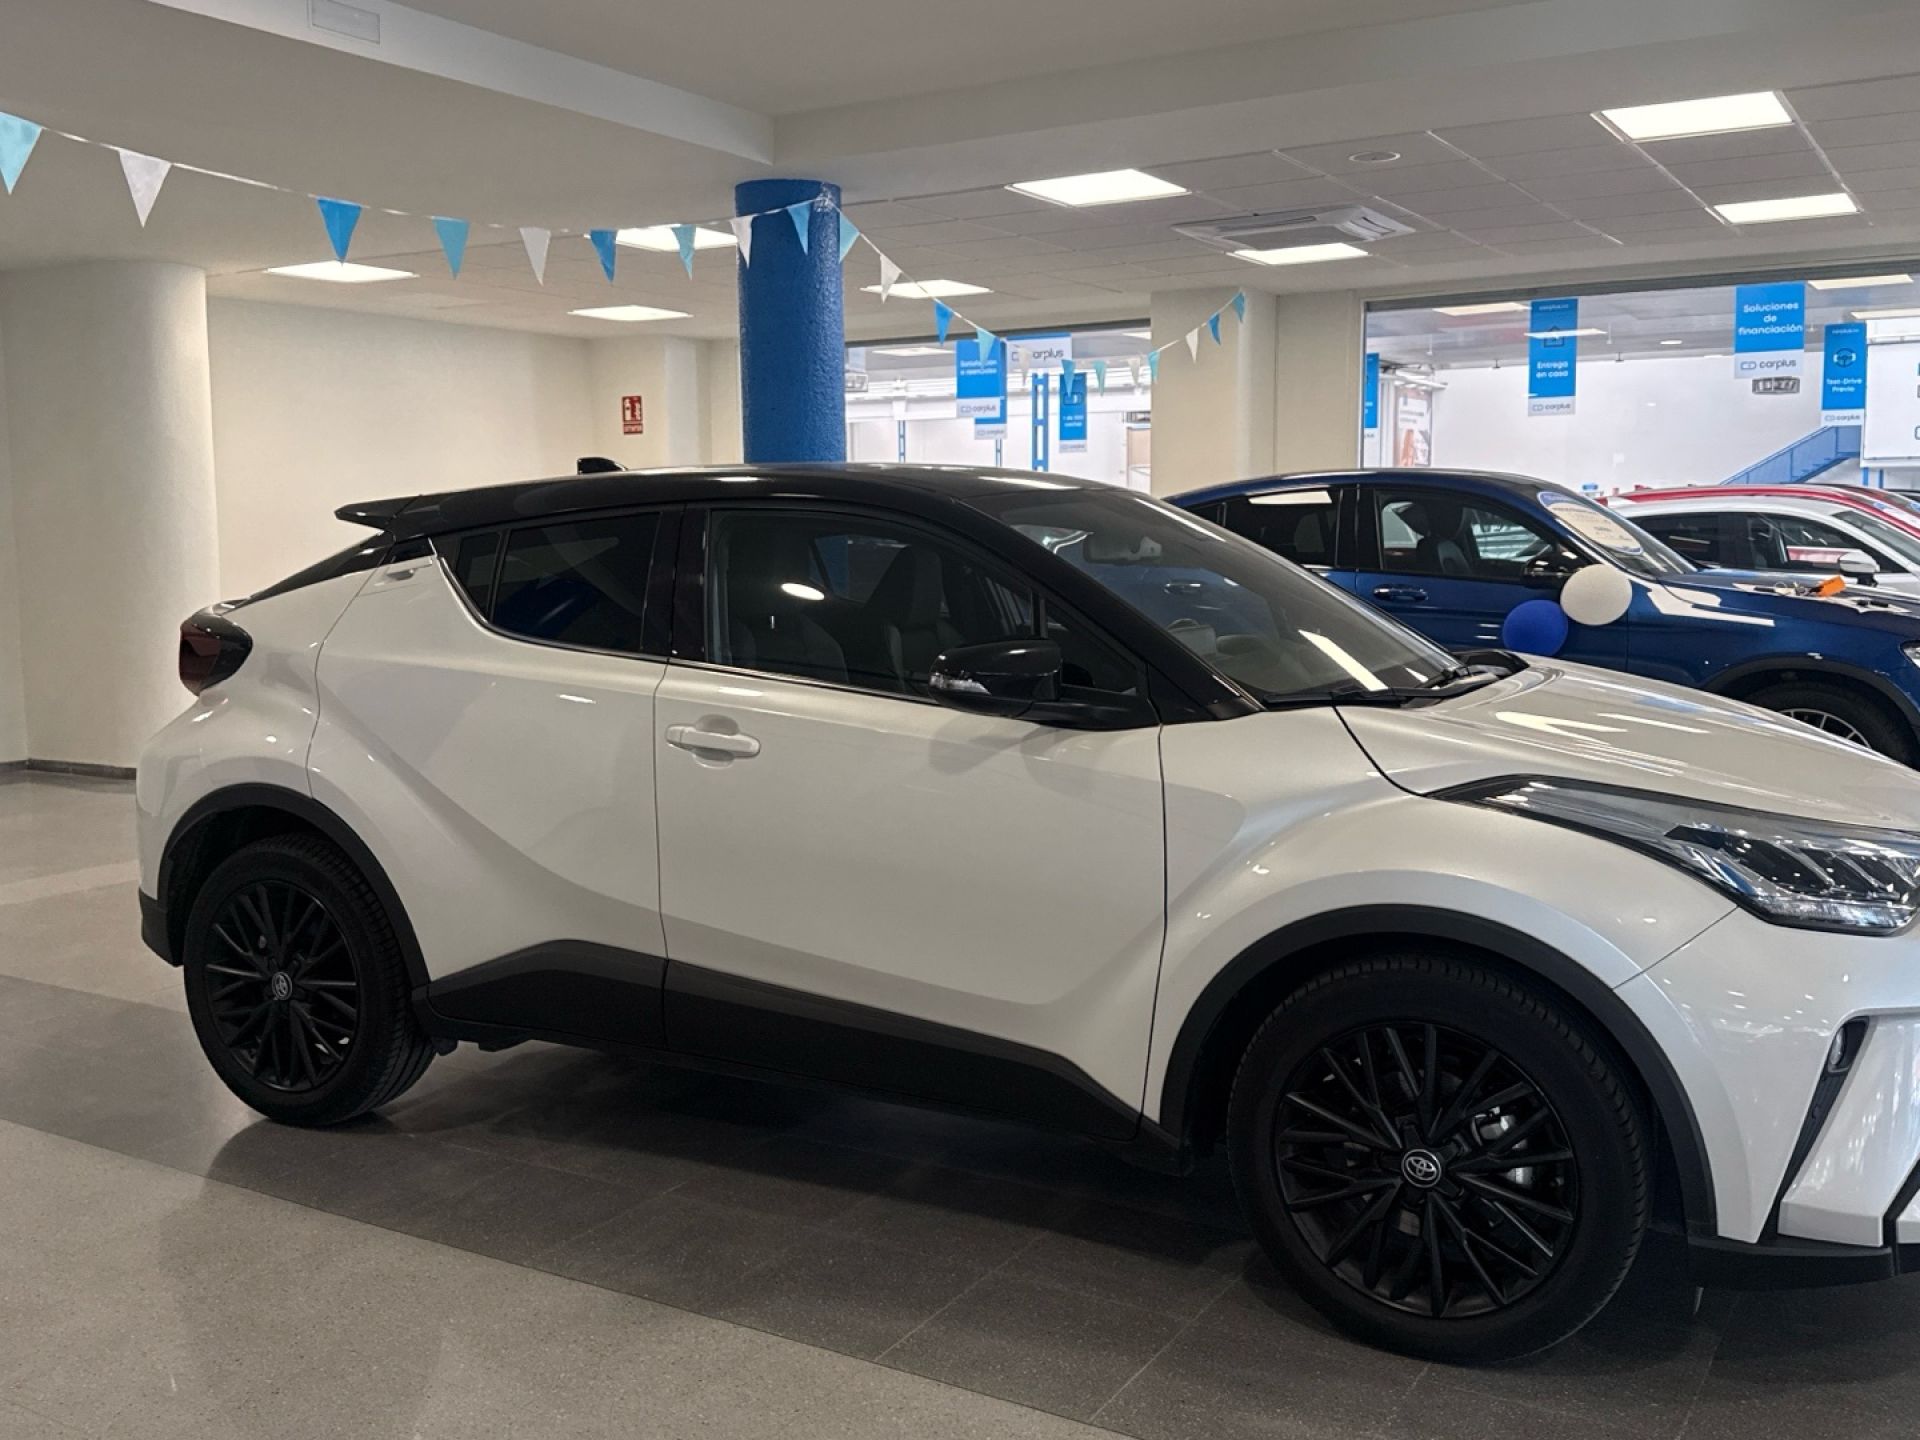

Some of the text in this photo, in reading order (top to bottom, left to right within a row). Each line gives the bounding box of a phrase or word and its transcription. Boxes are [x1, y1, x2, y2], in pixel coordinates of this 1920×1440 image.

[1744, 302, 1799, 313] Soluciones
[1763, 314, 1777, 323] de
[1738, 325, 1803, 336] financiación
[1030, 347, 1064, 360] arplus
[1537, 361, 1568, 369] Entrega
[1759, 359, 1797, 370] carplus
[1545, 403, 1570, 411] carplus
